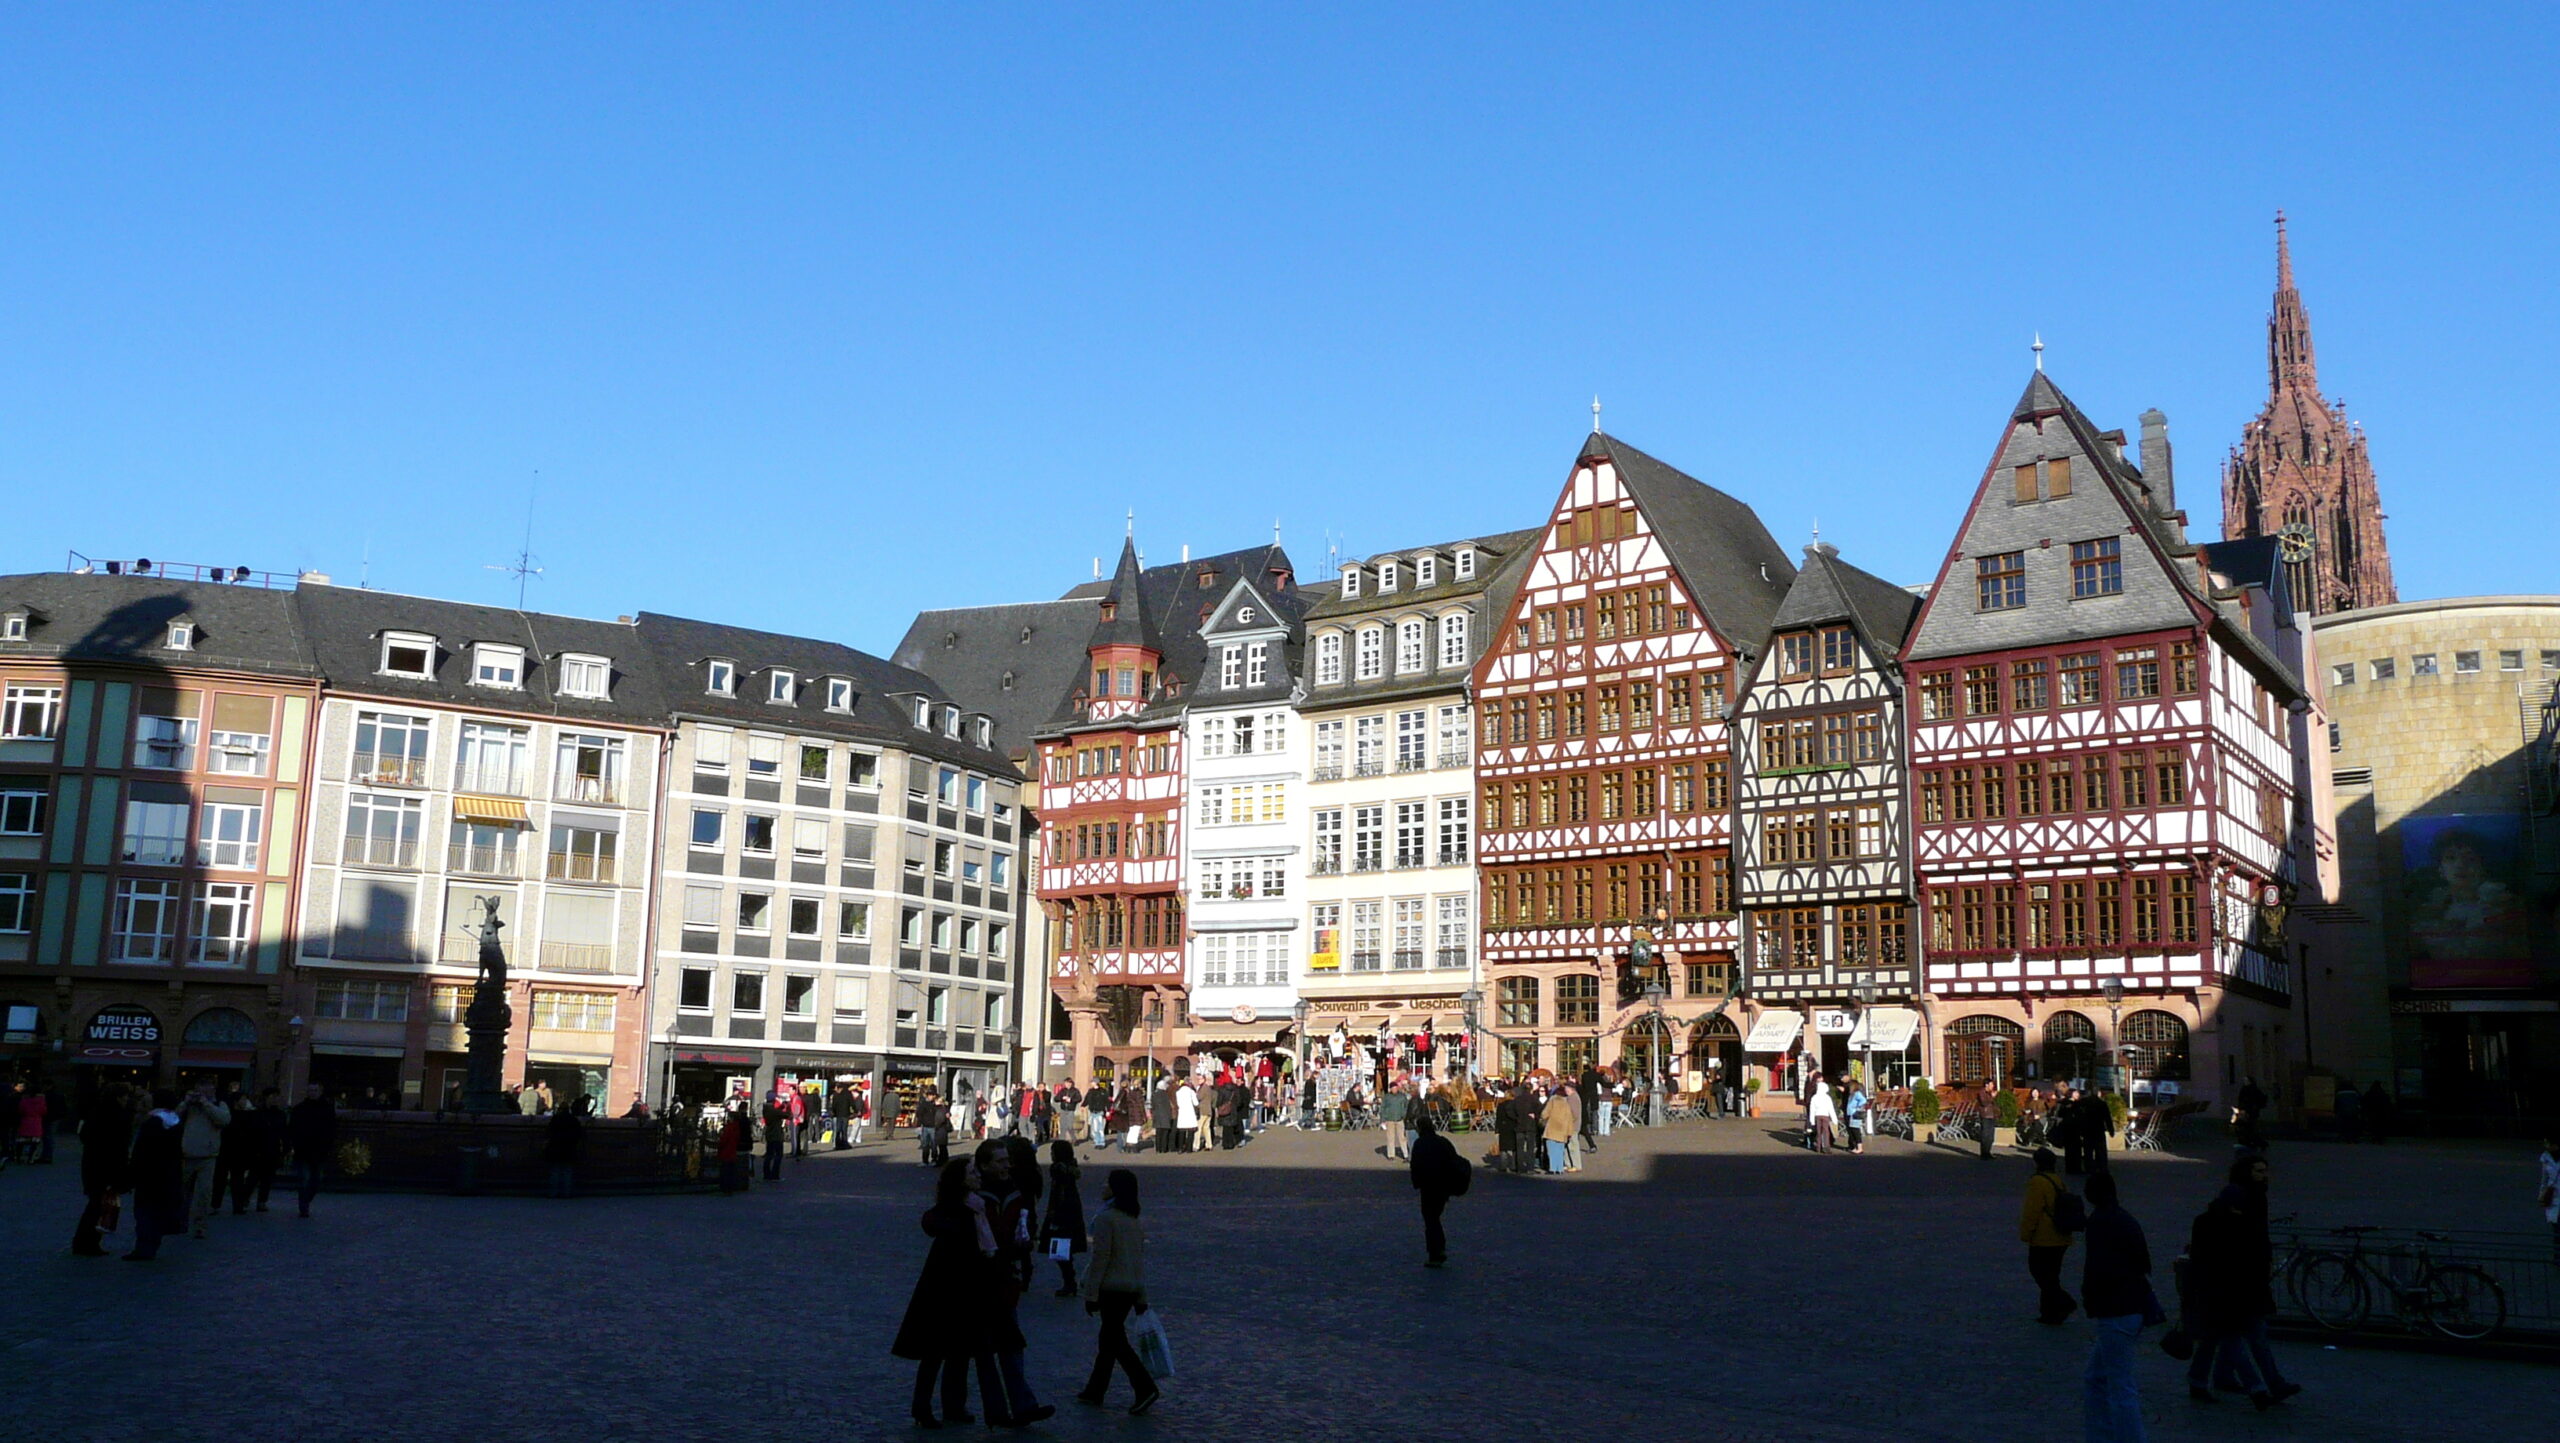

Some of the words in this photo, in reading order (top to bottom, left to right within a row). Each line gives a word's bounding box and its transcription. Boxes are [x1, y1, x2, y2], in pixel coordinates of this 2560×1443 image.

[1314, 1000, 1370, 1012] Souvenirs
[1409, 998, 1463, 1010] Geschen
[2391, 1000, 2449, 1013] SCHIRN
[97, 1014, 152, 1026] BRILLEN
[89, 1026, 159, 1041] WEISS
